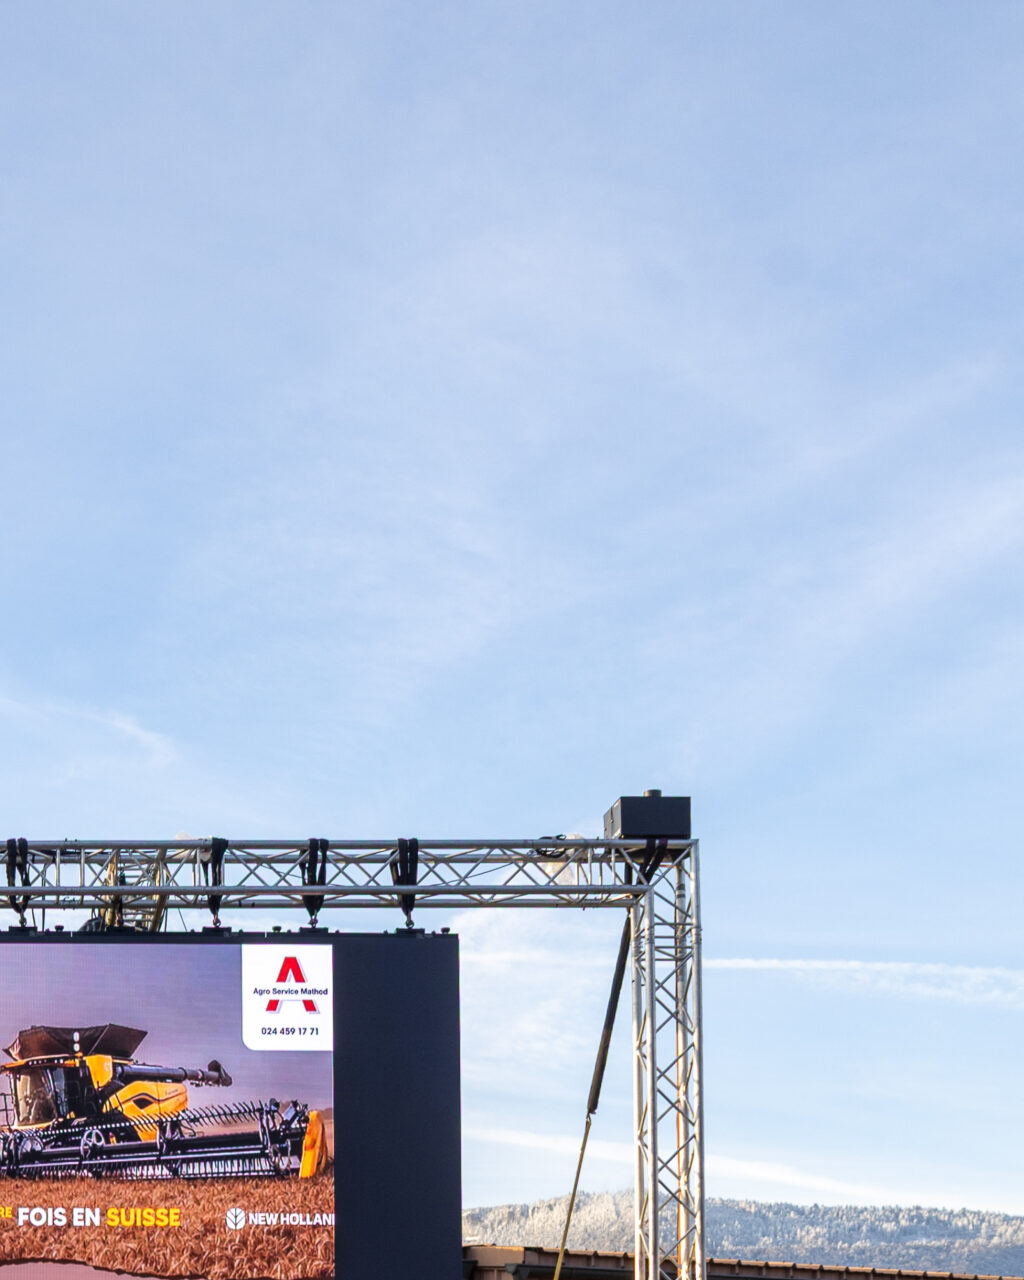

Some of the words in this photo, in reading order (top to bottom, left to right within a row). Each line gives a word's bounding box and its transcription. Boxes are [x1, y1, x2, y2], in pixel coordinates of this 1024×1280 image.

[253, 988, 270, 996] Agro
[261, 1027, 277, 1035] 024
[280, 1027, 296, 1035] 459
[298, 1027, 307, 1035] 17
[310, 1027, 319, 1035] 71
[18, 1207, 67, 1226] FOIS
[72, 1207, 100, 1226] EN
[106, 1207, 181, 1226] SUISSE
[248, 1212, 278, 1225] NEW
